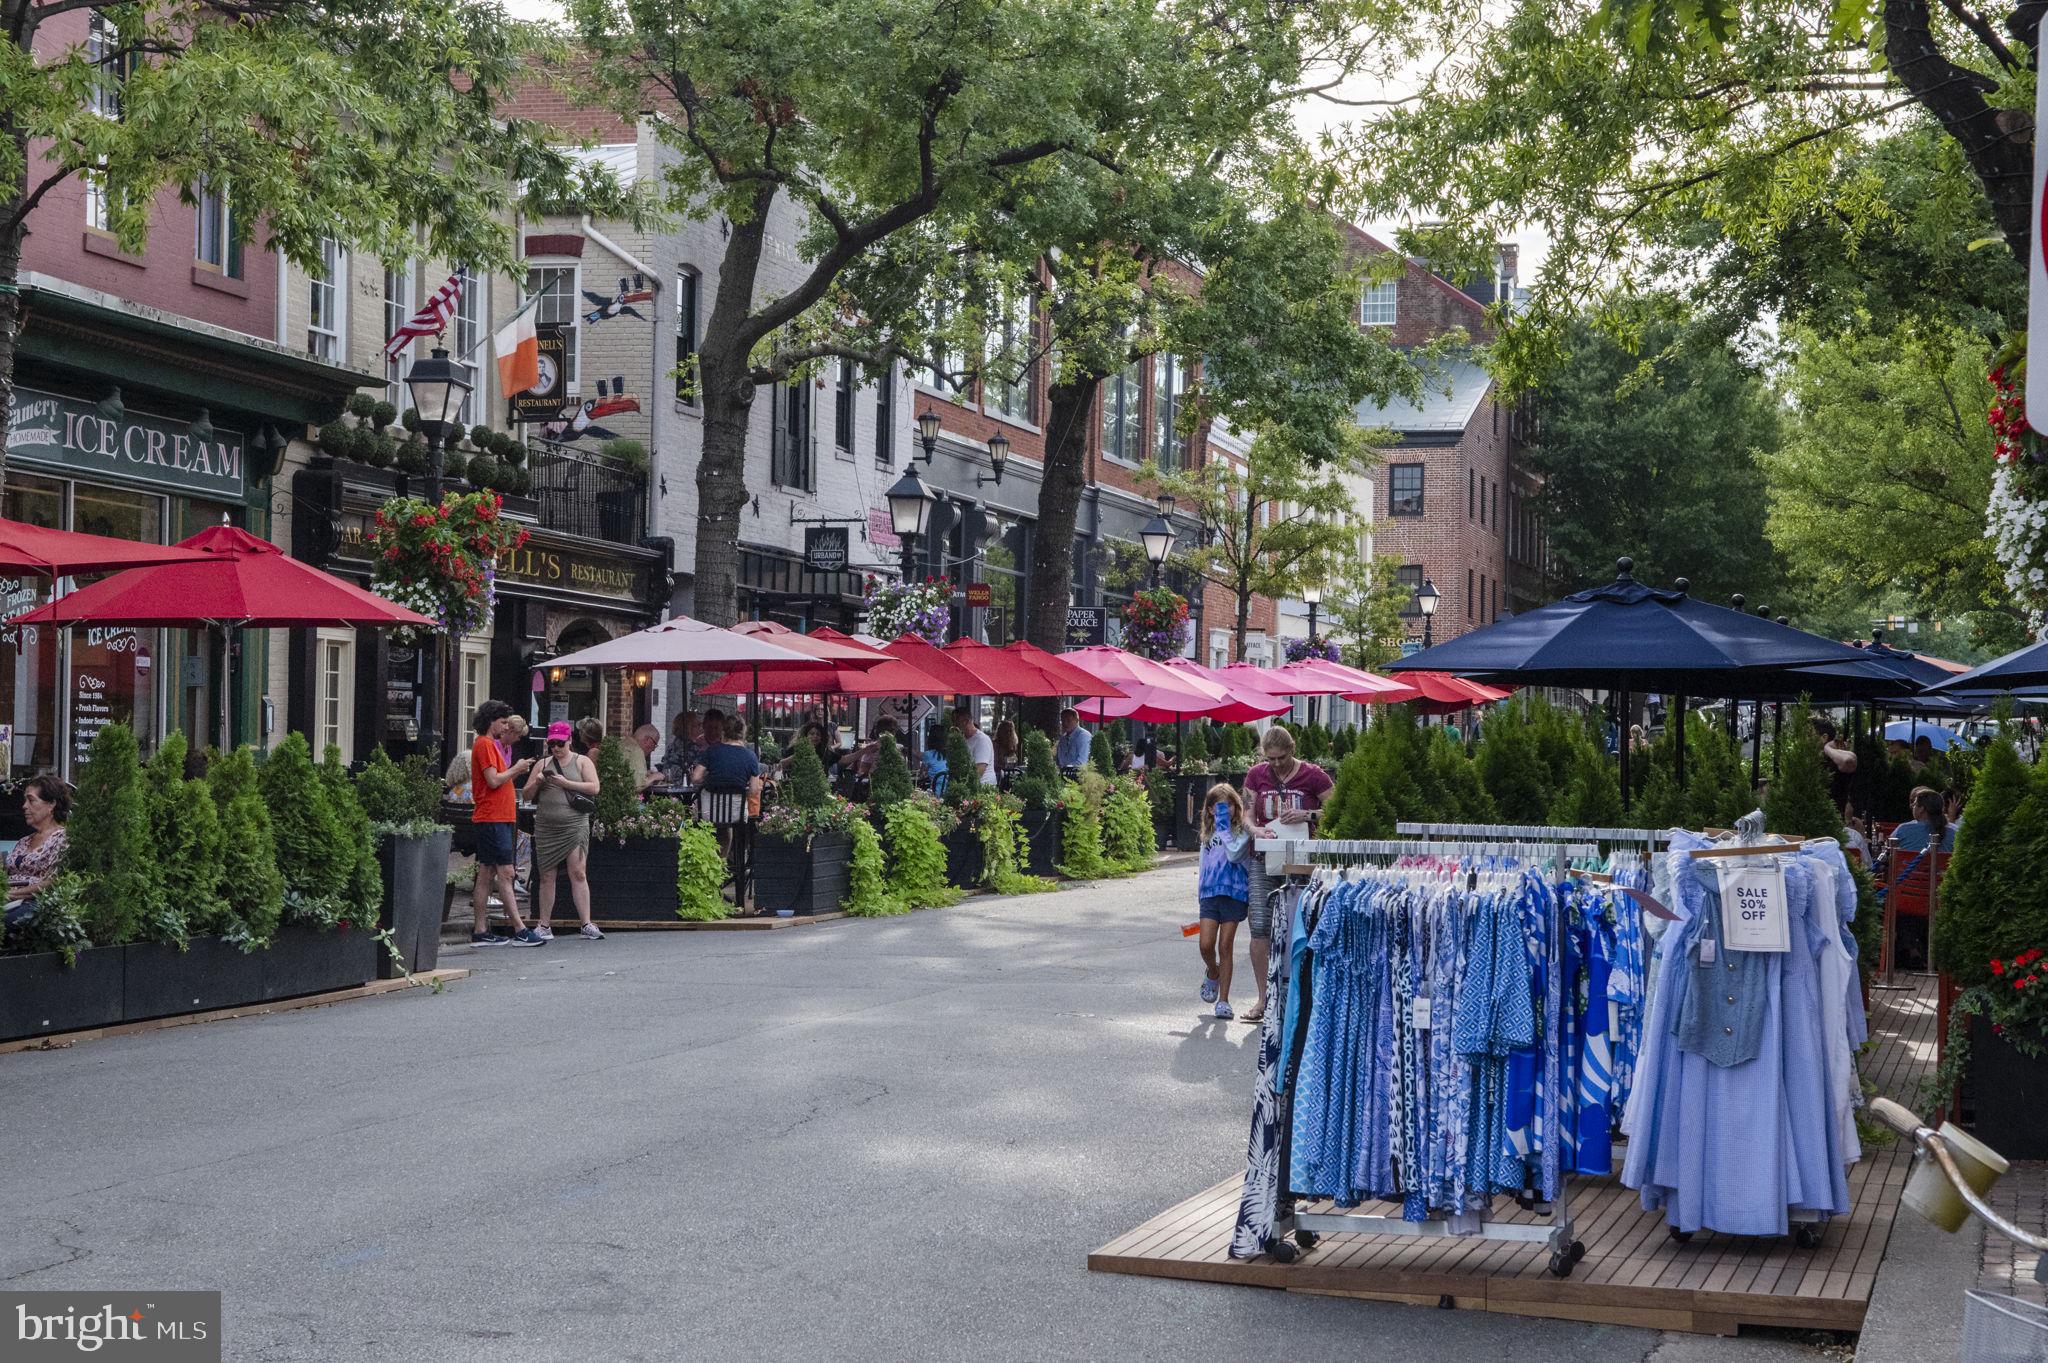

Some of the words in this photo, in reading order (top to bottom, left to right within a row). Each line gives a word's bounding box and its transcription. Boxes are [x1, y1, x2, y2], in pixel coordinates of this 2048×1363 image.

[518, 399, 562, 407] RESTAURANT
[10, 431, 50, 443] HOMEMADE
[62, 411, 119, 460] ICE
[124, 425, 241, 480] CREAM
[571, 563, 636, 588] RESTAURANT
[7, 588, 37, 609] FROZEN
[1067, 609, 1095, 619] PAPER
[88, 628, 102, 646] ICE
[79, 691, 91, 699] Since
[79, 704, 91, 712] Fresh
[92, 704, 108, 712] Flavors
[78, 717, 93, 725] Indoor
[1736, 887, 1768, 898] SALE
[1740, 899, 1766, 909] 50%
[1741, 910, 1766, 921] OFF
